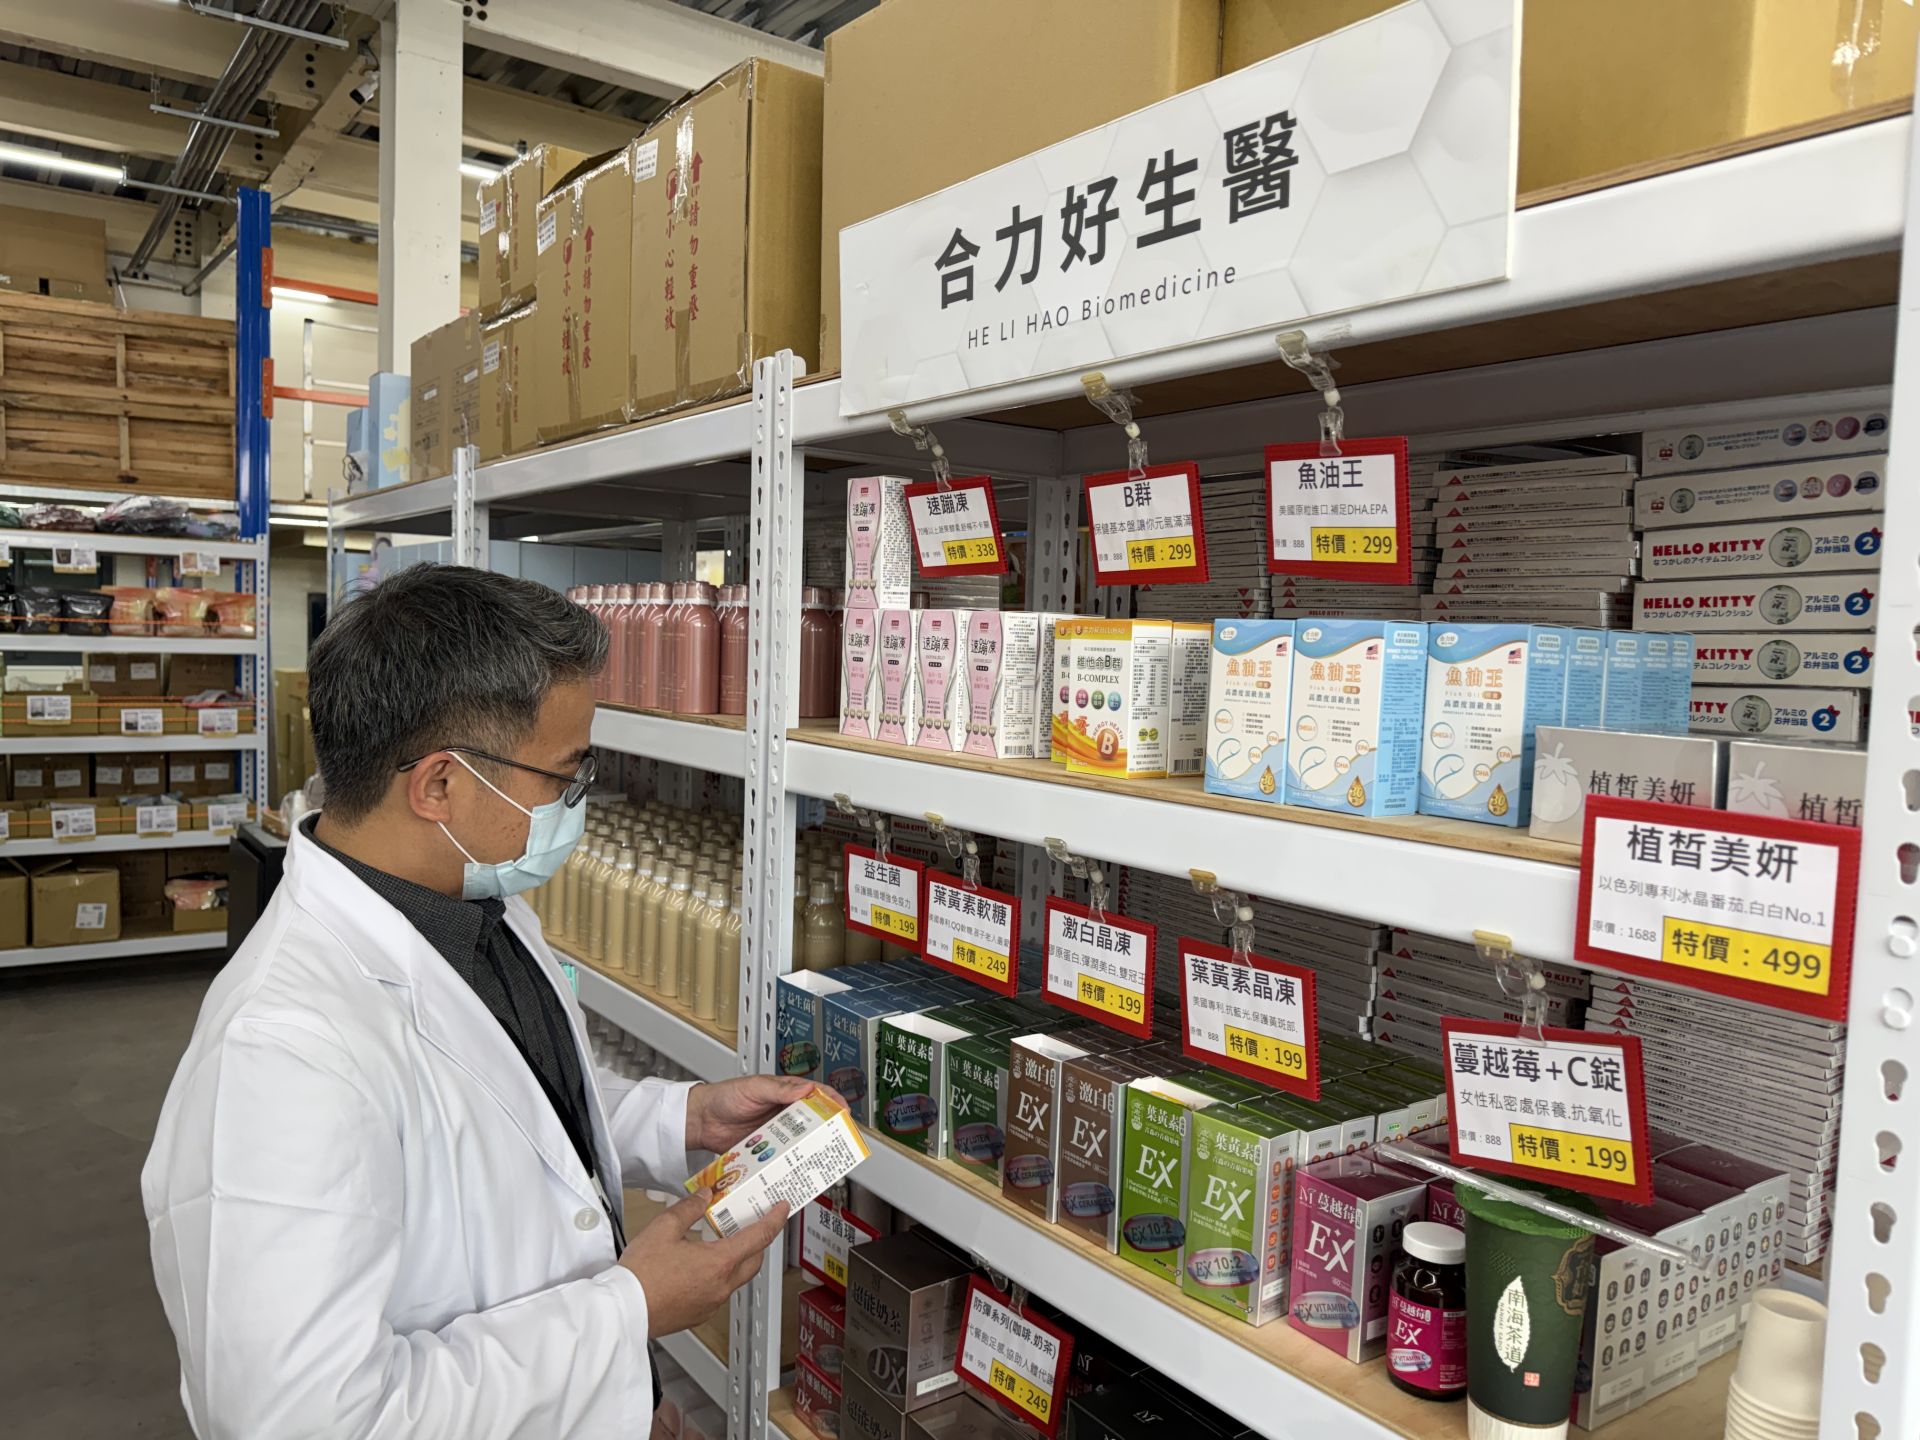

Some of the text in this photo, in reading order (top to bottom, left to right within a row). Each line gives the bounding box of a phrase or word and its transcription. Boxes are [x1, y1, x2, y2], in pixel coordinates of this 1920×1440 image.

[934, 110, 1299, 309] 合力好生醫
[664, 218, 676, 331] 小心輕放
[968, 265, 1237, 349] HE LI HAO Biomedicine
[1298, 460, 1364, 490] 魚油王
[926, 492, 969, 516] 速蹦凍
[1123, 482, 1151, 507] B群
[1653, 539, 1766, 557] HELLO KITTY
[1815, 535, 1849, 545] アルミの
[1653, 553, 1763, 566] なつかしのアイテムコレクション
[1643, 595, 1756, 609] HELLO KITTY
[1805, 595, 1840, 604] アルミの
[1643, 609, 1753, 619] なつかしのアイテムコレクション
[1077, 655, 1122, 671] 維他命B群
[1226, 657, 1272, 678] 魚油王
[1696, 648, 1754, 660] KITTY
[1803, 652, 1838, 661] アルミの
[1077, 674, 1119, 684] B-COMPLEX
[1310, 661, 1361, 682] 魚油王
[1445, 666, 1503, 687] 魚油王
[1689, 702, 1728, 714] ITTY
[1774, 708, 1807, 717] アルミの
[864, 860, 900, 887] 益生菌
[933, 884, 1007, 927] 葉黃素軟糖
[1062, 915, 1132, 956] 激白晶凍
[1672, 928, 1822, 980] 特價：499
[1191, 957, 1297, 1006] 葉黃素晶凍
[825, 1033, 843, 1061] EX
[897, 1031, 927, 1060] 葉黃素
[882, 1059, 906, 1089] EX
[962, 1059, 994, 1089] 葉黃素
[1025, 1056, 1050, 1086] 激白
[1452, 1042, 1624, 1093] 蔓越莓+C錠
[950, 1084, 972, 1116] EX
[1079, 1080, 1109, 1110] 激白
[1015, 1090, 1049, 1133] EX
[1146, 1104, 1179, 1131] 葉黃素
[1070, 1116, 1107, 1159] EX
[1215, 1132, 1254, 1163] 葉黃素
[1517, 1133, 1627, 1172] 特價：199
[1136, 1144, 1178, 1190] EX
[1202, 1174, 1251, 1221] EX
[819, 1206, 856, 1246] 速循環
[1147, 1222, 1172, 1236] 10:2
[1304, 1220, 1355, 1273] EX
[827, 1257, 845, 1280] 特價
[1196, 1255, 1243, 1279] EX 10:2
[1314, 1303, 1347, 1314] VITAMIN
[1395, 1318, 1422, 1345] EX
[1504, 1288, 1524, 1364] 南海茶道
[871, 1348, 906, 1397] DX
